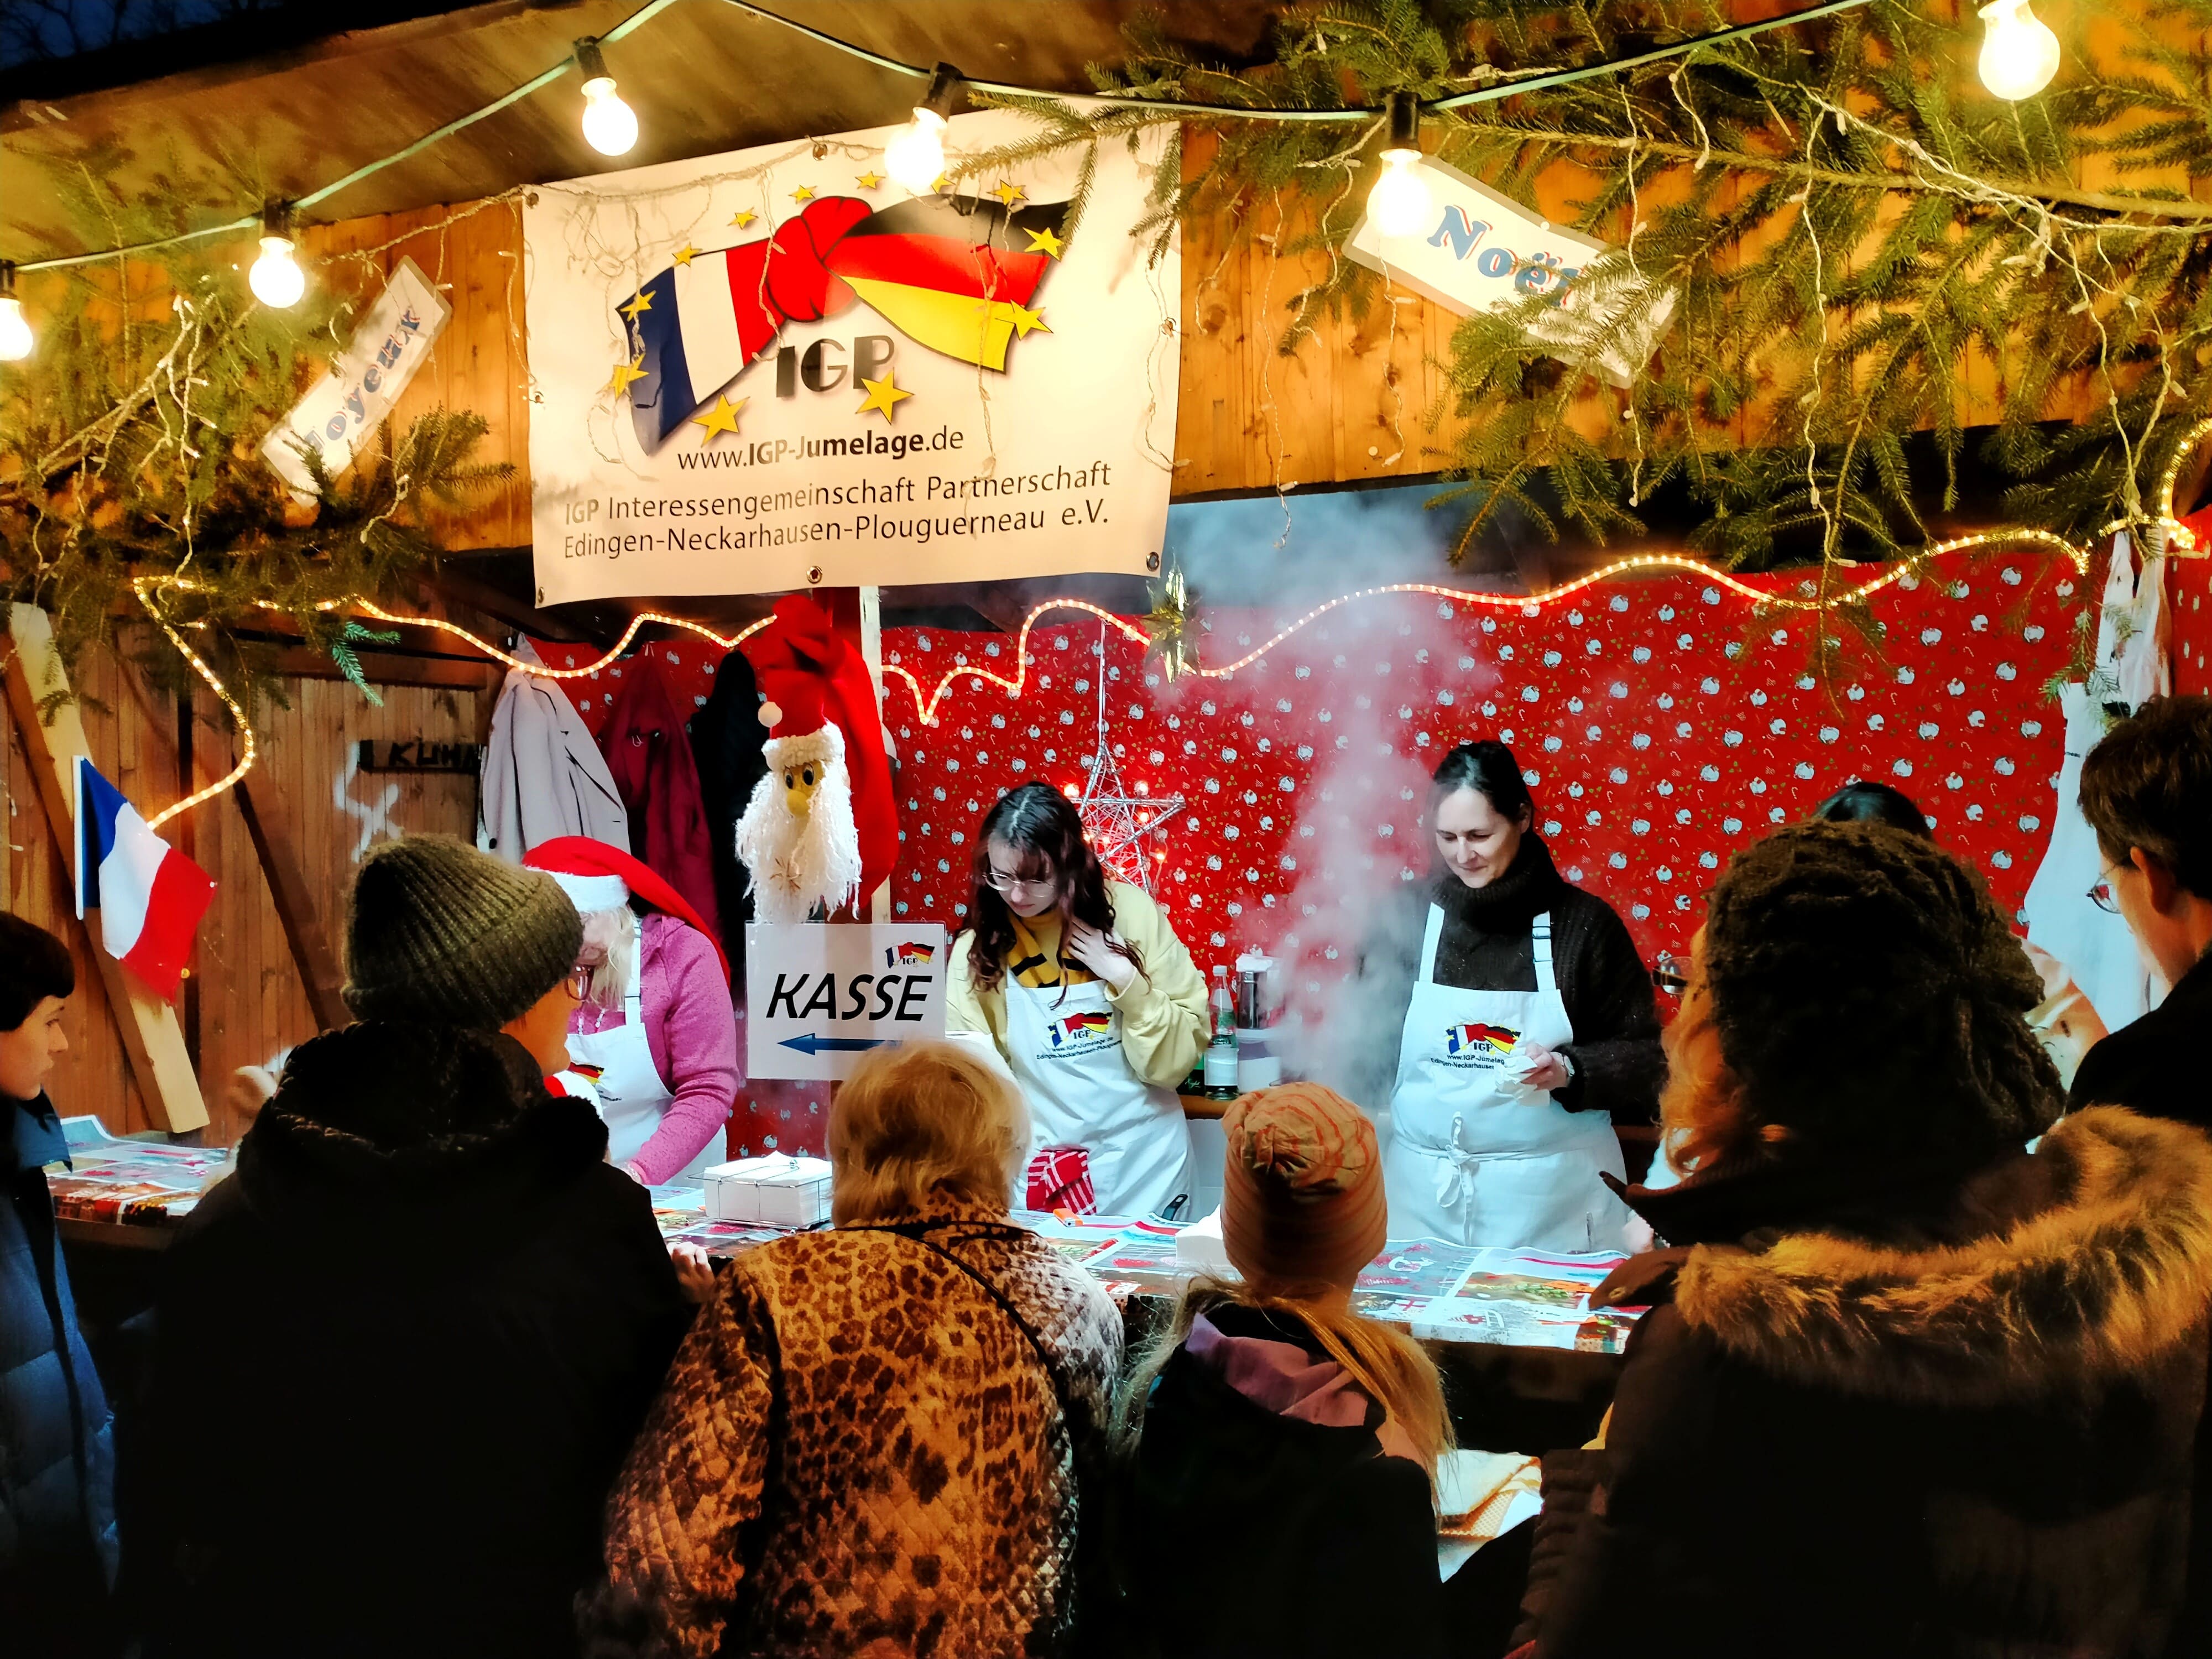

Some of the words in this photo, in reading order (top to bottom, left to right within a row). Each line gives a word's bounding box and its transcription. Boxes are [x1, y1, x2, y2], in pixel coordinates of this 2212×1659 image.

[775, 335, 895, 398] IGP
[677, 425, 964, 469] www.IGP-Jumelage.de
[565, 498, 599, 525] IGP
[609, 476, 915, 520] Interessengemeinschaft
[927, 460, 1111, 500] Partnerschaft
[564, 510, 1045, 559] Edingen-Neckarhausen-Plouguerneau
[1061, 498, 1108, 525] e.V.
[902, 957, 919, 966] IGP
[766, 973, 933, 1021] KASSE
[1073, 1030, 1091, 1040] IGP
[1474, 1041, 1493, 1052] IGP
